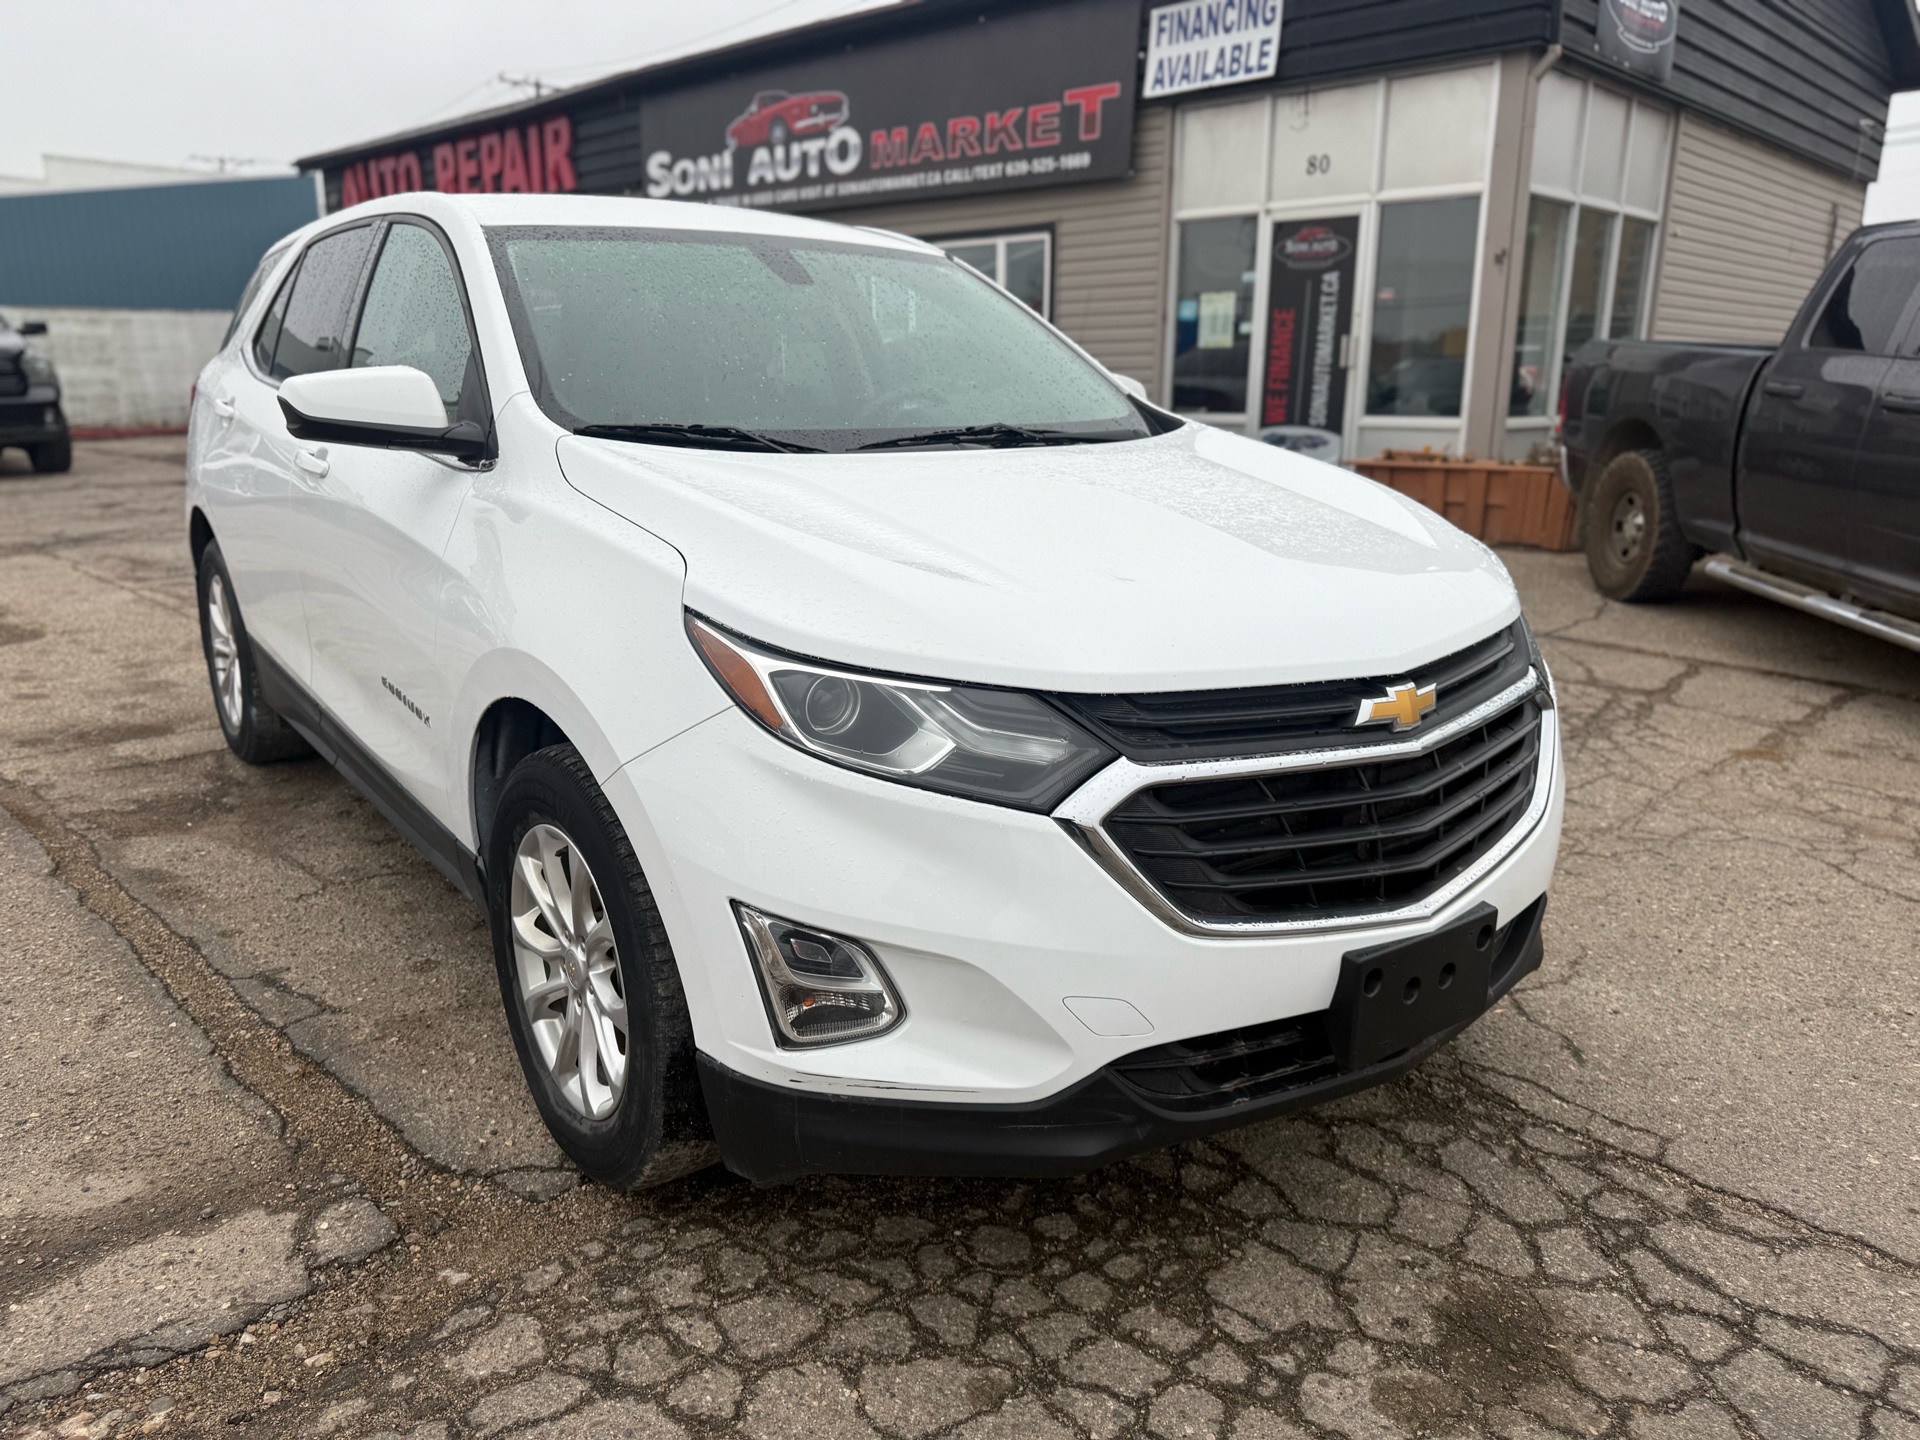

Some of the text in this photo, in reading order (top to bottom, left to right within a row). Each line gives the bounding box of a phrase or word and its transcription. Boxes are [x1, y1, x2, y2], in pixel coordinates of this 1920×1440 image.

[1156, 0, 1277, 47] FINANCING
[1152, 39, 1272, 91] AVAILABLE
[341, 115, 576, 208] AUTO REPAIR
[747, 126, 862, 186] AUTO
[871, 82, 1120, 169] MARKET
[1306, 154, 1331, 175] 80
[1265, 308, 1295, 424] WE FINANCE
